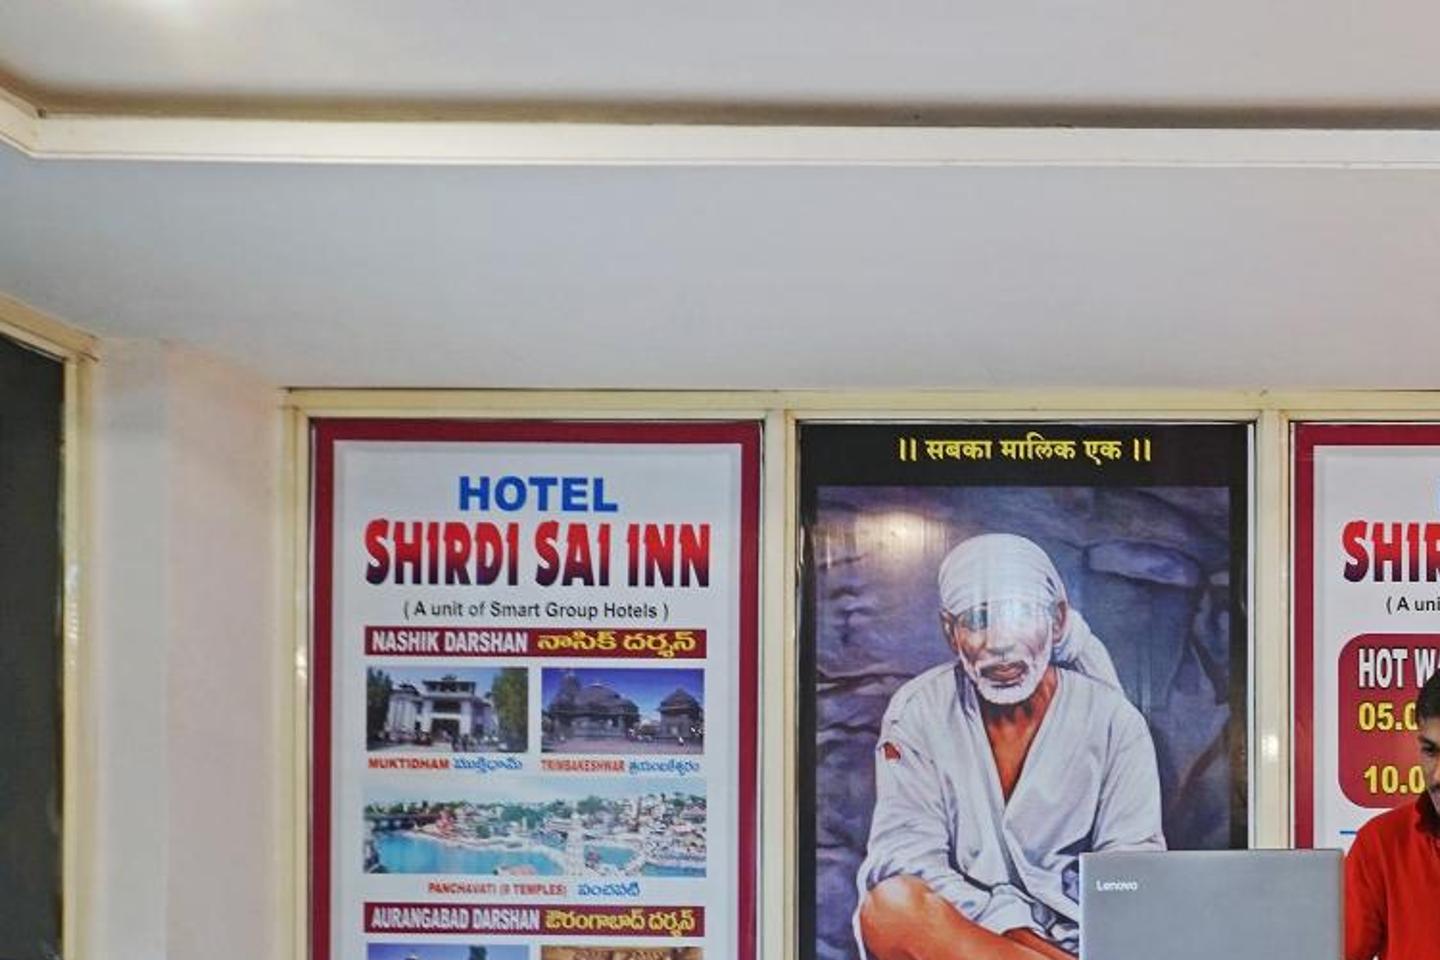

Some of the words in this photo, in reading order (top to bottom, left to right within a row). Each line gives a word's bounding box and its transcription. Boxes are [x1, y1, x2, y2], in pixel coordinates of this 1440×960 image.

[924, 439, 993, 460] सबका
[999, 431, 1076, 460] मालिक
[1082, 439, 1122, 465] एक
[459, 476, 618, 512] HOTEL
[364, 519, 518, 586] SHIRDI
[534, 520, 610, 587] SAI
[627, 523, 710, 587] INN
[431, 601, 463, 617] unit
[468, 601, 486, 617] of
[490, 601, 540, 618] Smart
[546, 602, 598, 621] Group
[604, 602, 658, 618] Hotels
[371, 630, 439, 652] NASHIK
[444, 631, 529, 653] DARSHAN
[1358, 648, 1408, 688] HOT
[1358, 702, 1418, 730] 05.0
[367, 757, 450, 769] MUKTIDHAM
[1364, 765, 1426, 793] 10.0
[1095, 879, 1138, 891] Lenovo
[371, 907, 469, 930] AURANGABAD
[473, 908, 541, 930] DARSHAN
